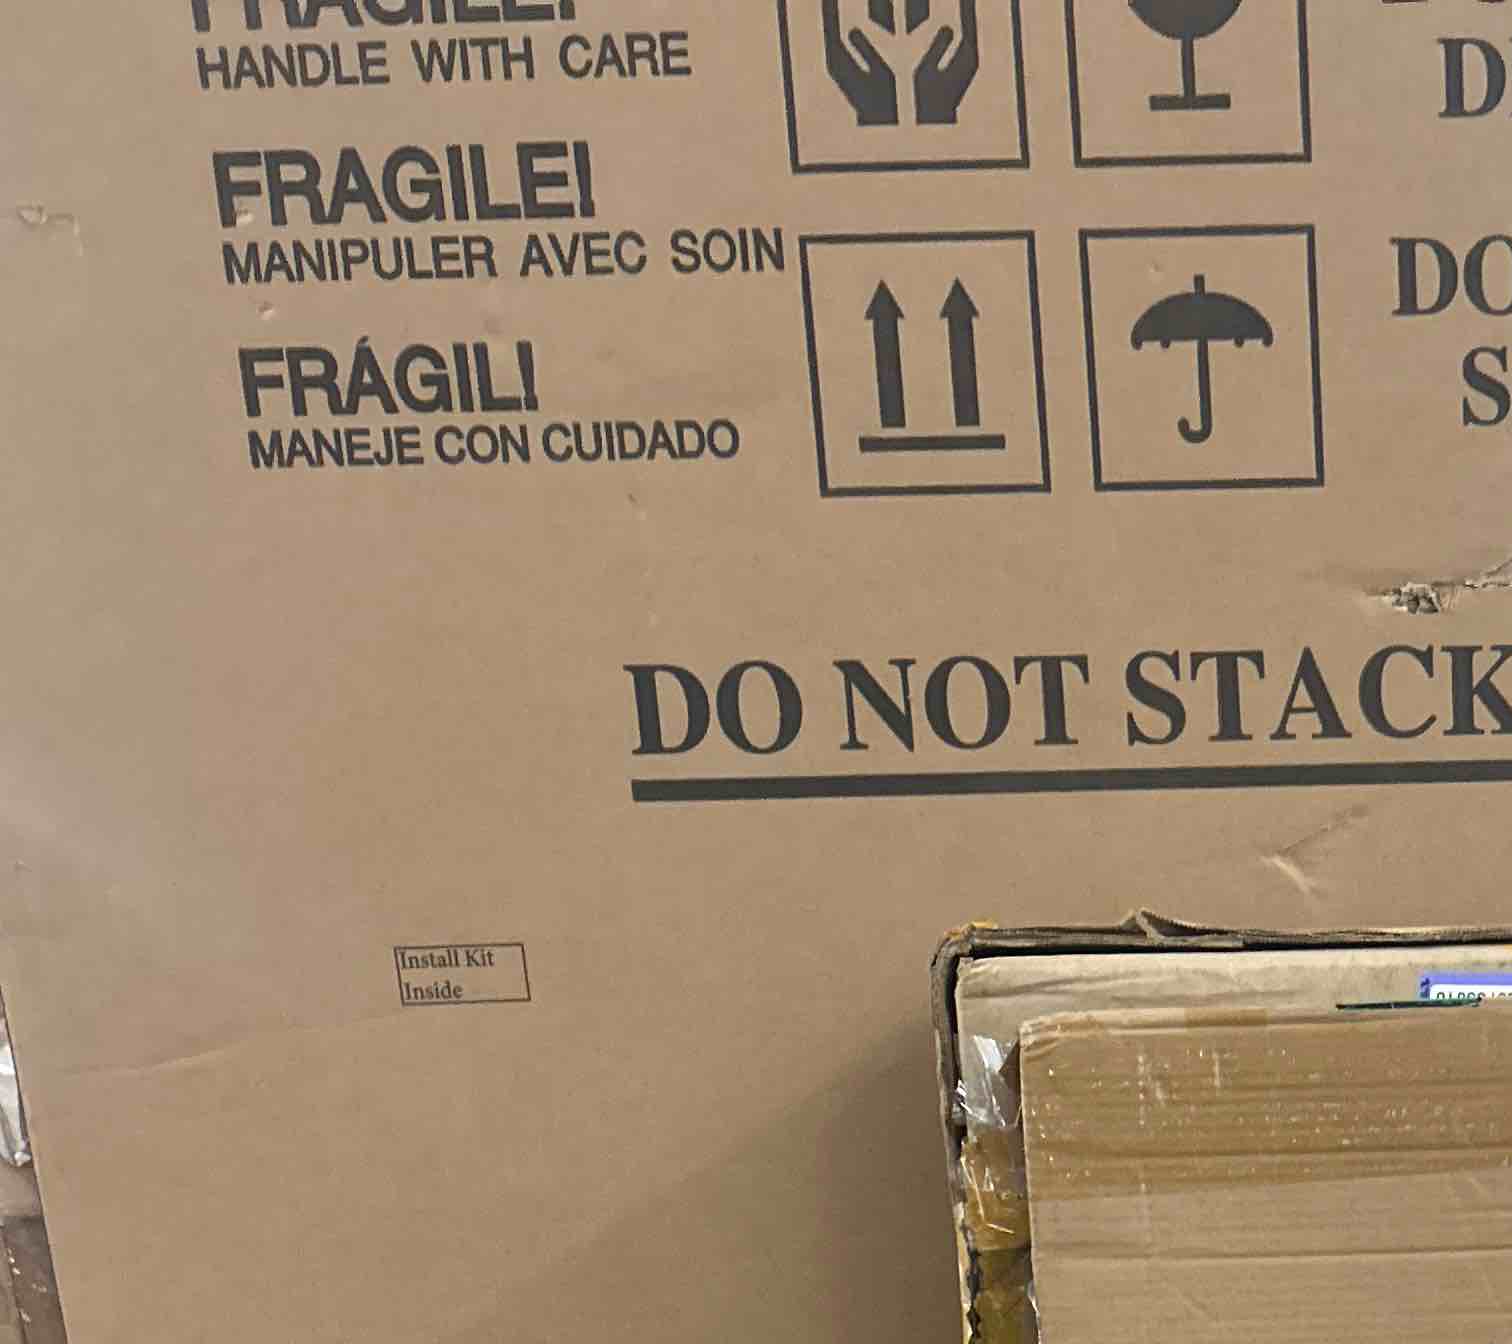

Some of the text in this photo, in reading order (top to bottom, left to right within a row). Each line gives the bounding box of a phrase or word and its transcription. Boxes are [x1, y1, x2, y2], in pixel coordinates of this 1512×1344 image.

[196, 31, 692, 90] HANDLE WITH CARE
[222, 227, 785, 284] MANIPULER AVEC SOIN
[248, 419, 740, 468] MANEJE CON CUIDADO
[625, 662, 802, 755] DO
[834, 654, 1089, 753] NOT
[400, 949, 495, 969] Install Kit
[403, 982, 463, 1000] Inside
